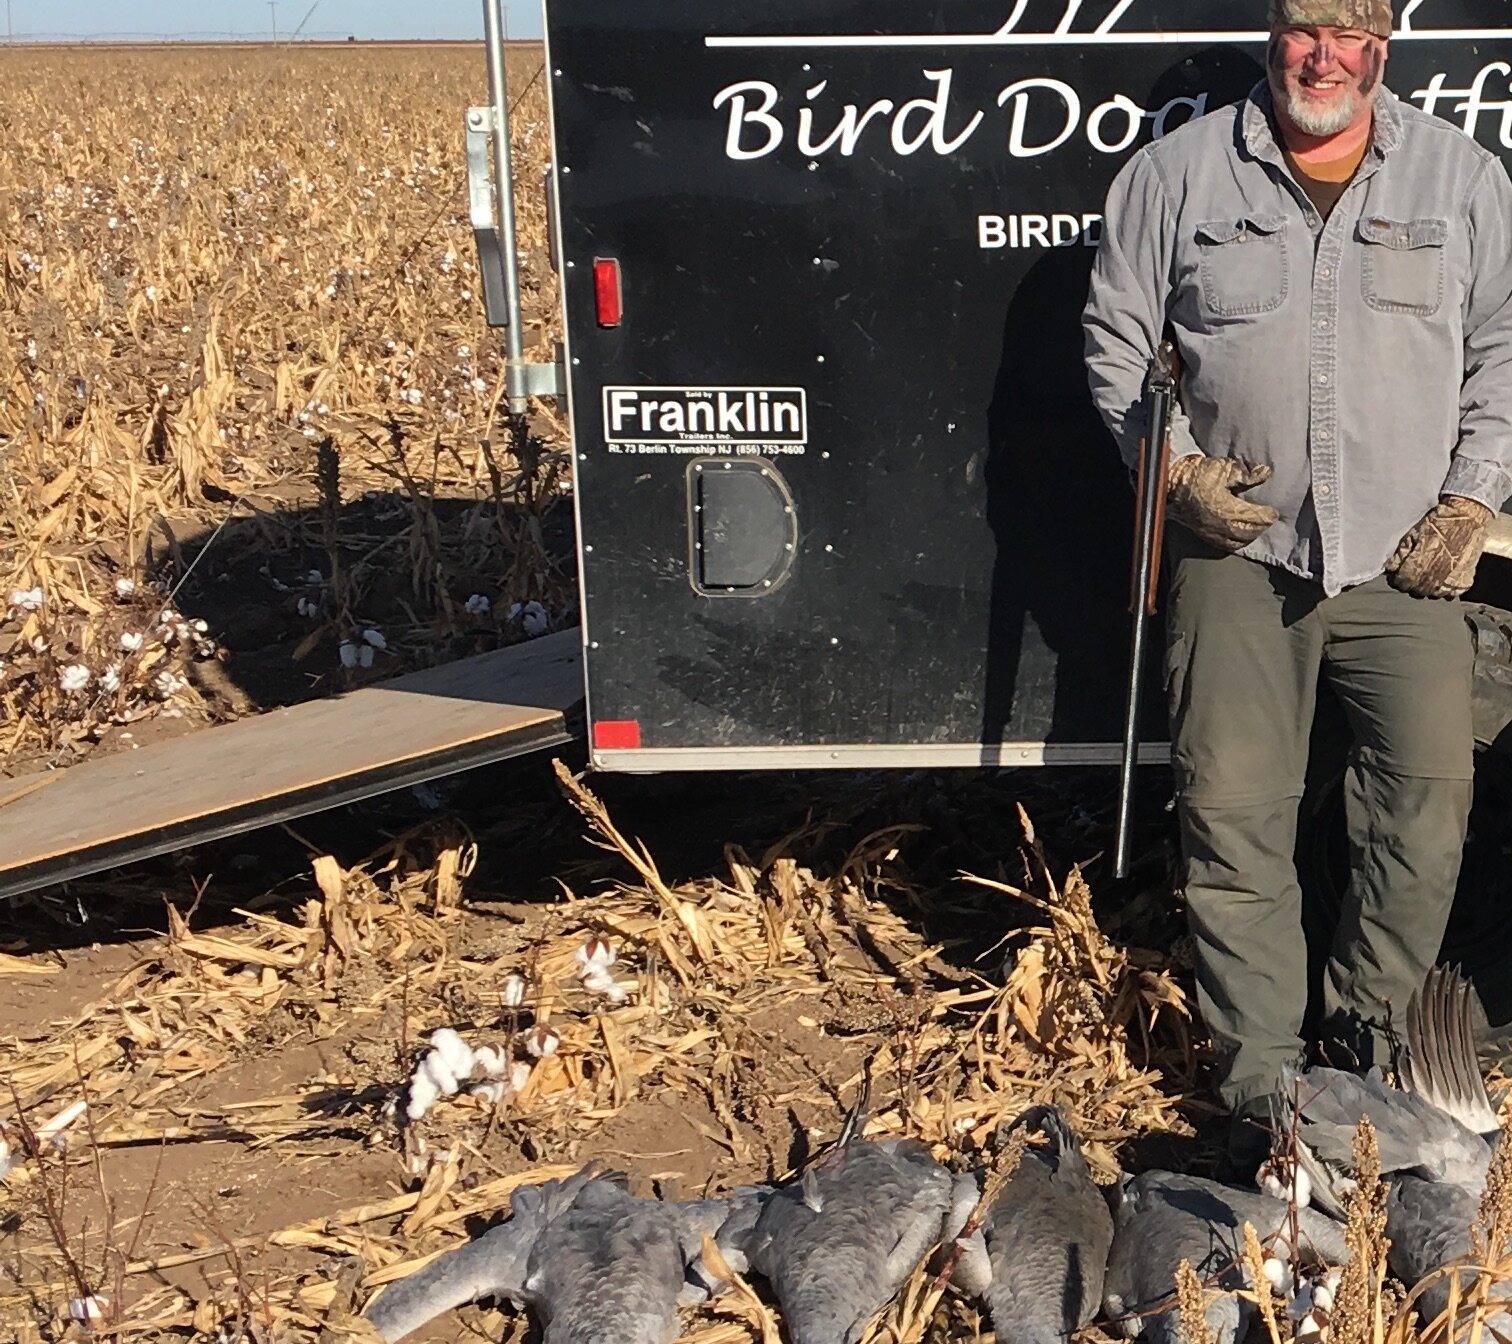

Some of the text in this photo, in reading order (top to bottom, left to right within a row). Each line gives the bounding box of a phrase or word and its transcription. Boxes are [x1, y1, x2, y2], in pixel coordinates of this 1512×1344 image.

[712, 67, 984, 160] Bird
[611, 391, 800, 432] Franklin
[679, 432, 714, 440] Trailers
[624, 444, 637, 454] 73
[638, 444, 668, 454] Berlin
[669, 444, 716, 456] Township
[718, 444, 732, 454] NJ
[736, 444, 760, 456] (856)
